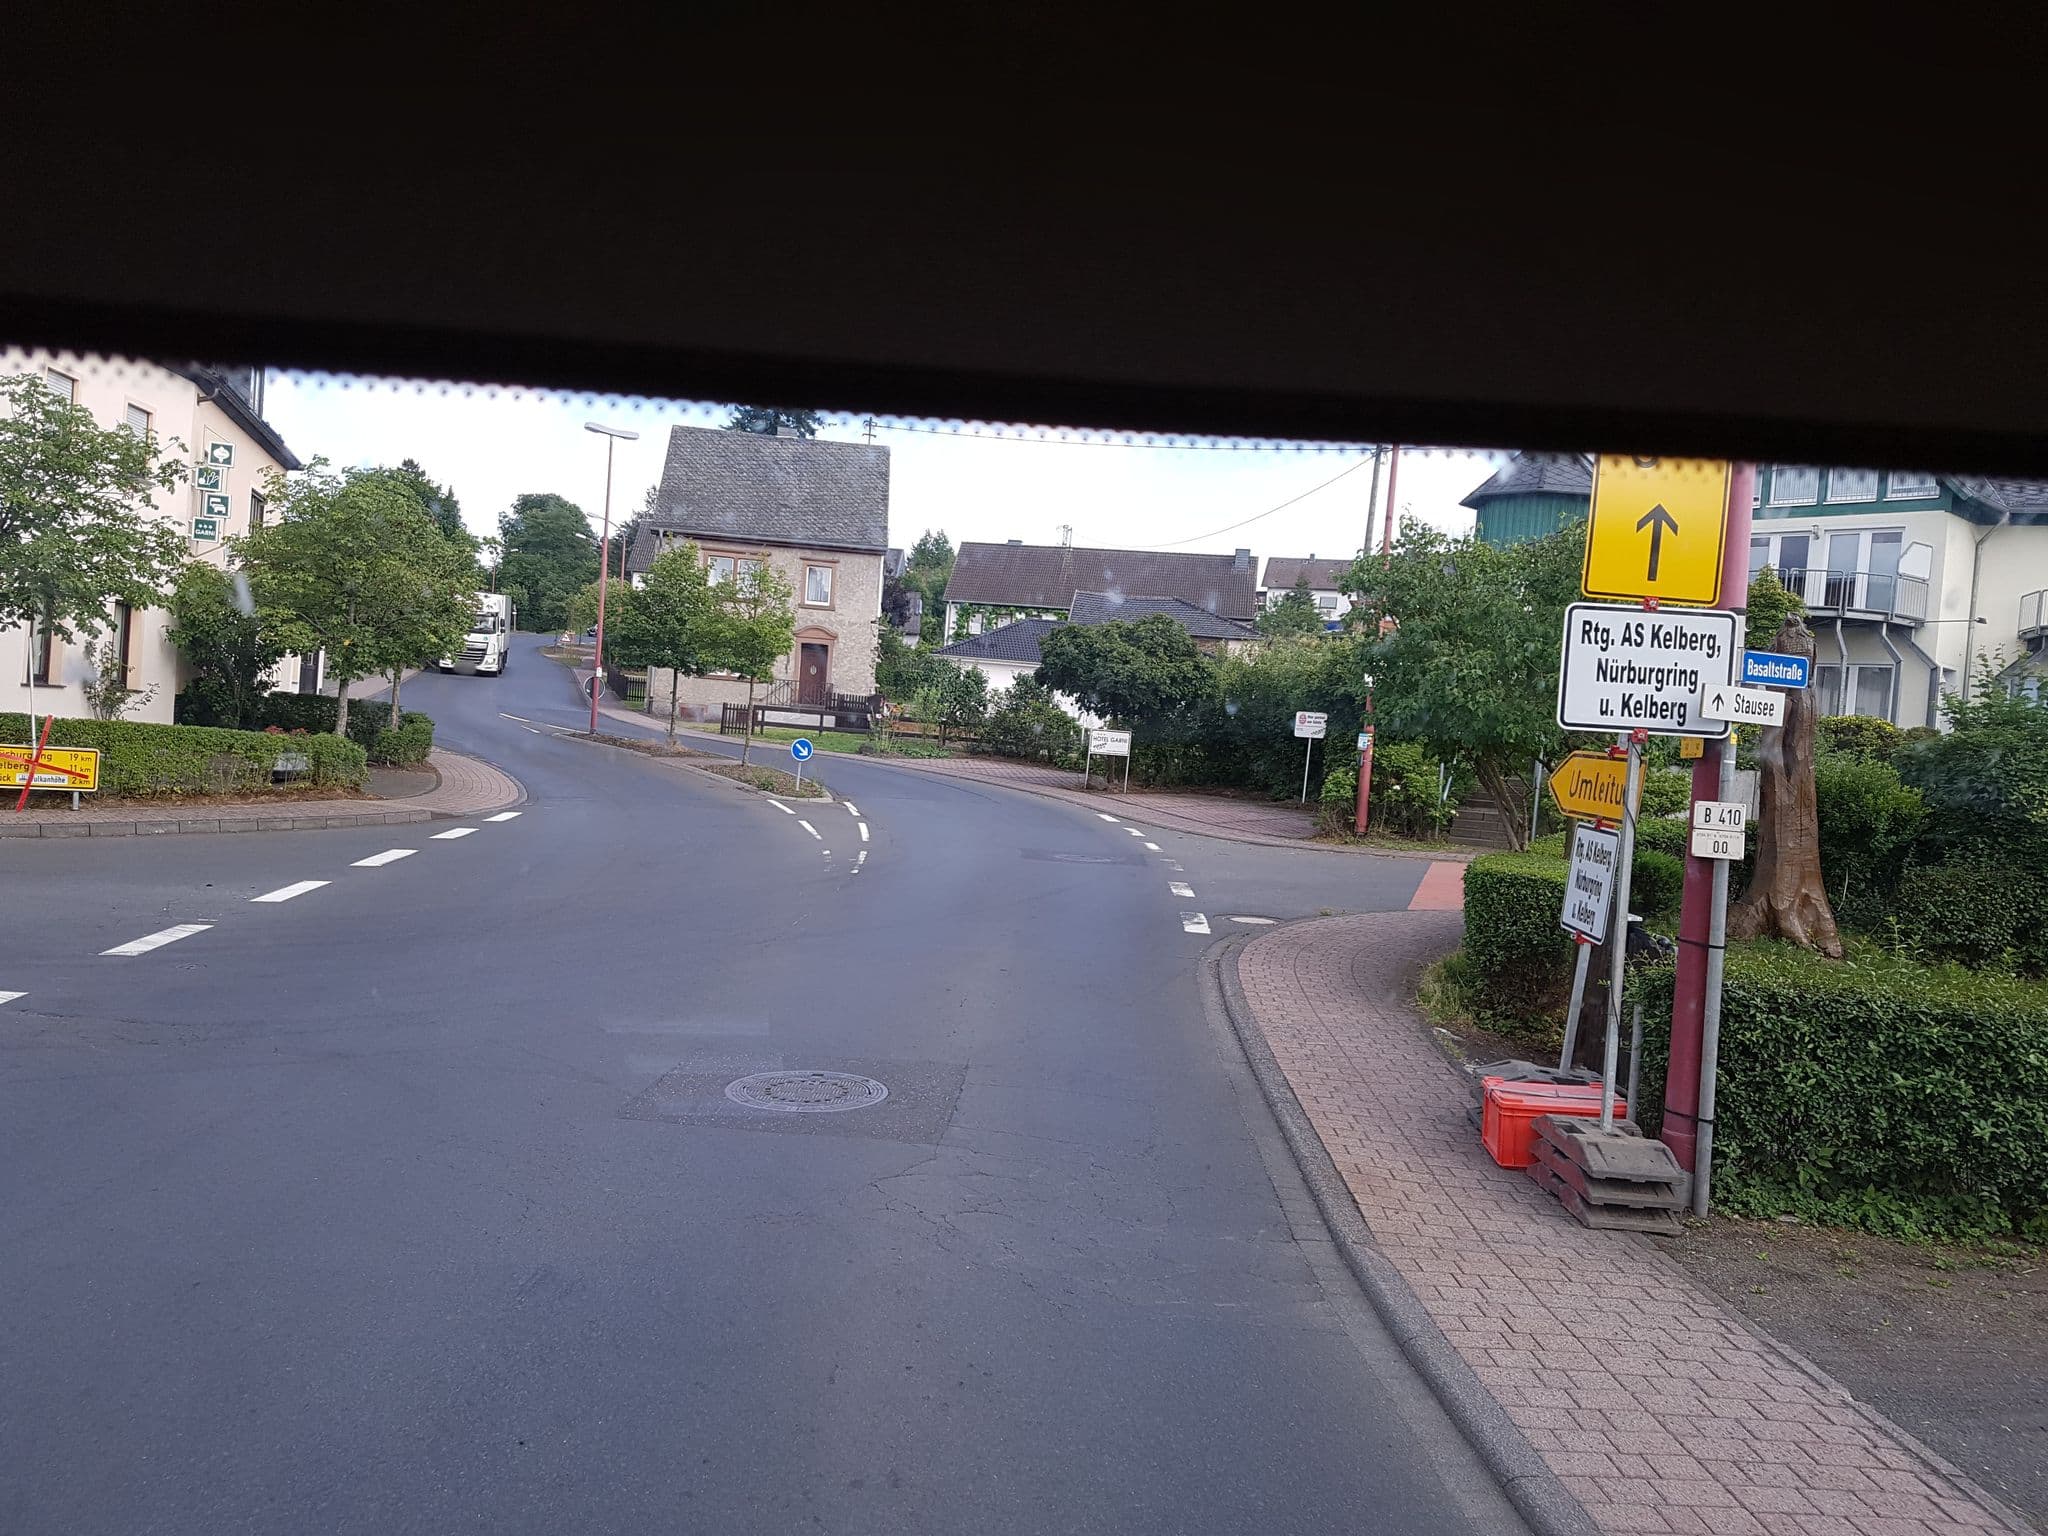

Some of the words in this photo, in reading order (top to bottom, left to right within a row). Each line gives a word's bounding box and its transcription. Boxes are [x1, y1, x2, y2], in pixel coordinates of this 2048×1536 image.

[1581, 620, 1615, 651] Rtg.
[1621, 622, 1645, 647] AS
[1650, 624, 1721, 659] Kelberg,
[1596, 657, 1699, 694] Nürburgring
[1747, 658, 1803, 681] Basaltstraße
[1599, 698, 1614, 717] u.
[1620, 693, 1687, 727] Kelberg
[1734, 693, 1775, 716] Stausee
[70, 753, 79, 761] 19
[80, 755, 92, 763] km
[70, 764, 77, 773] 11
[34, 775, 66, 784] ulkanhöhe
[71, 776, 77, 785] 2
[1569, 769, 1626, 808] Umleitu
[1704, 807, 1712, 824] B
[1718, 808, 1742, 827] 410
